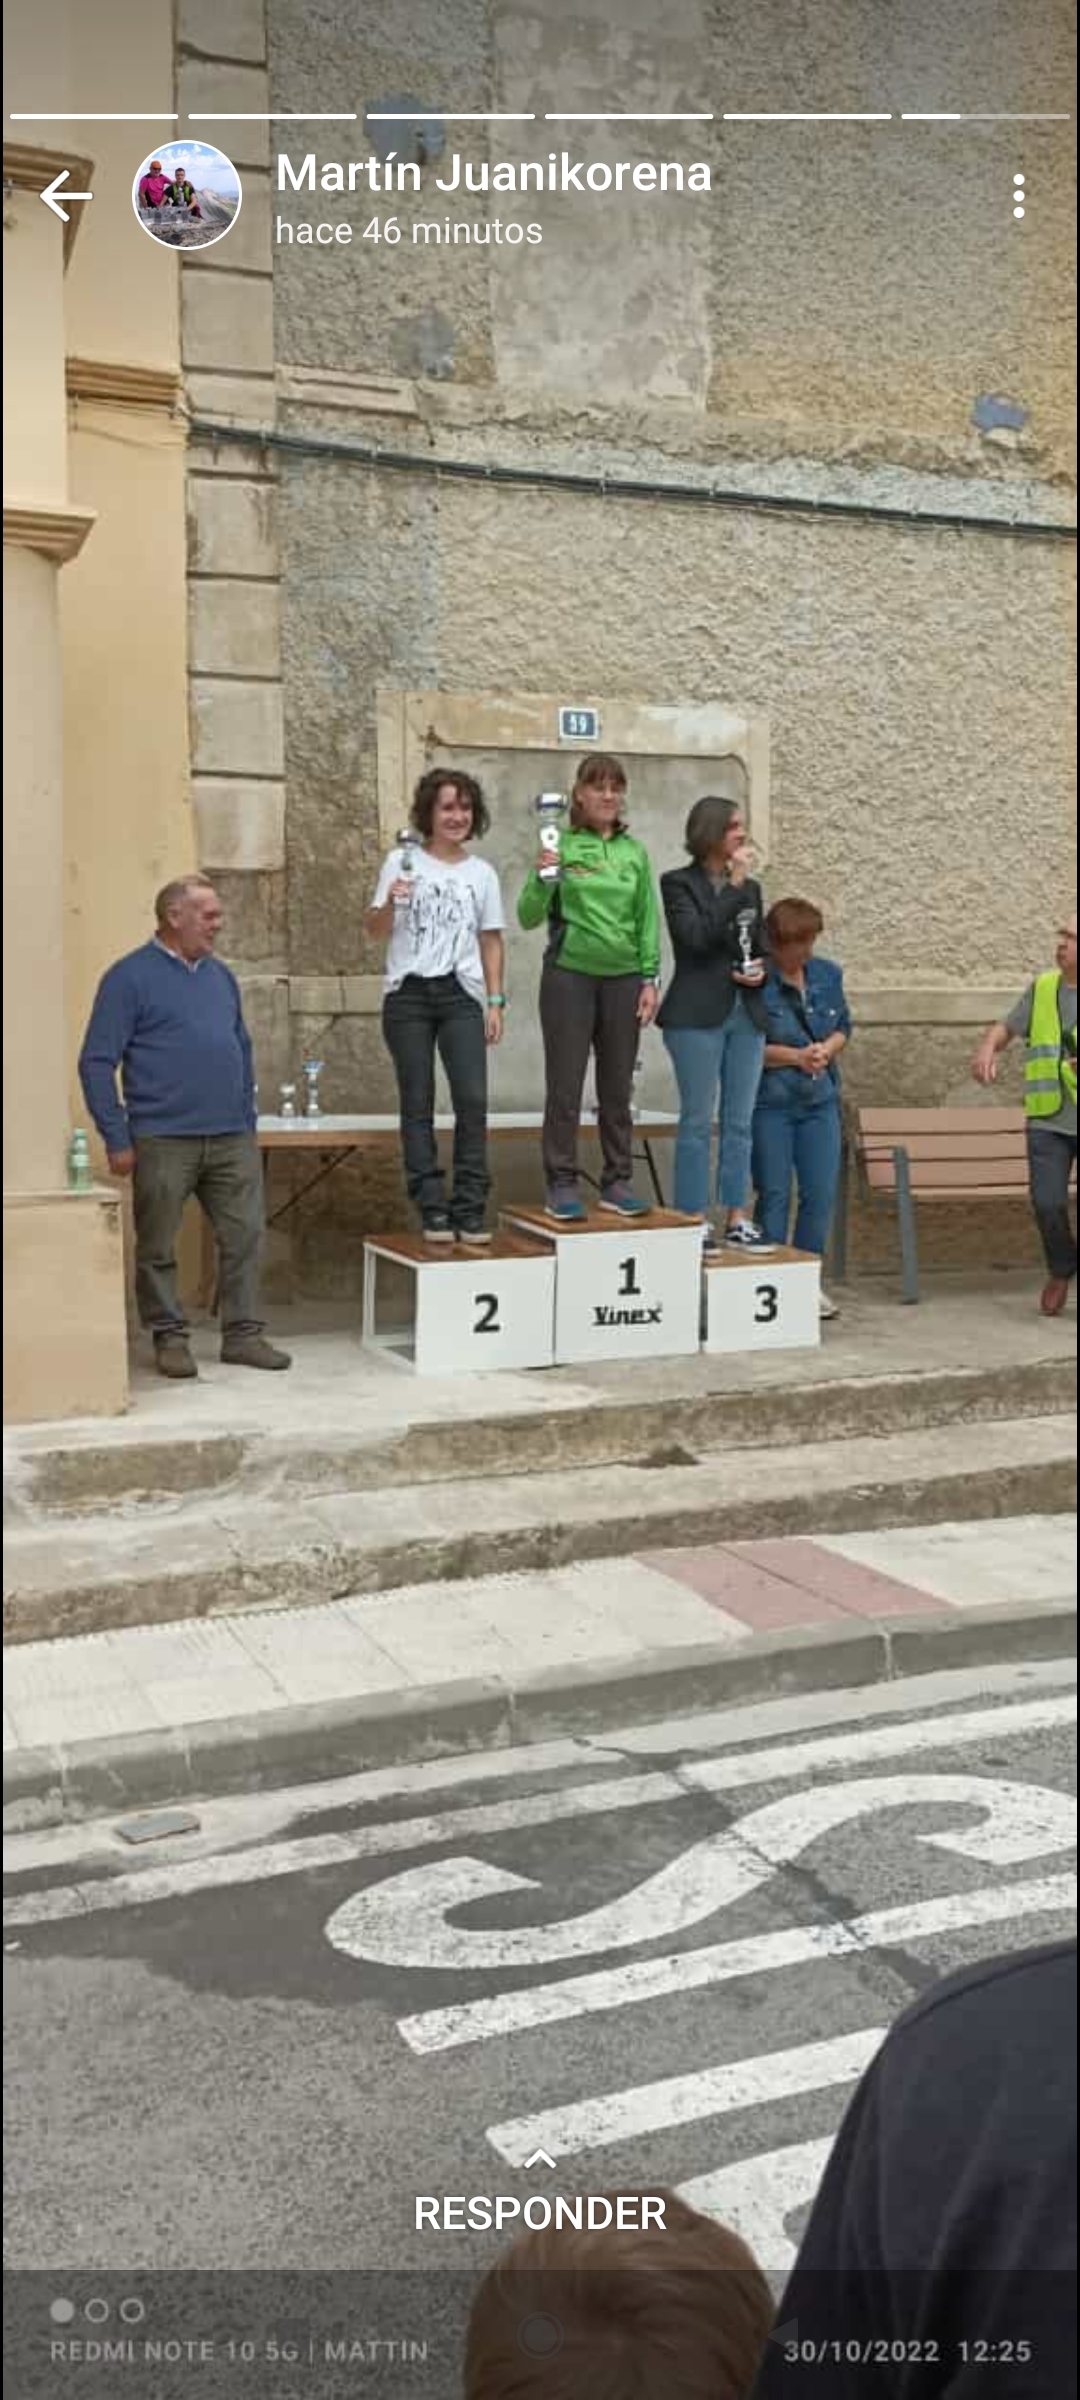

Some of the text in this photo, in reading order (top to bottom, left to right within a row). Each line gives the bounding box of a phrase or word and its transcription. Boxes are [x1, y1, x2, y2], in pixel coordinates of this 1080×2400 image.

[618, 1257, 641, 1295] 1
[473, 1293, 500, 1333] 2
[753, 1285, 779, 1323] 3
